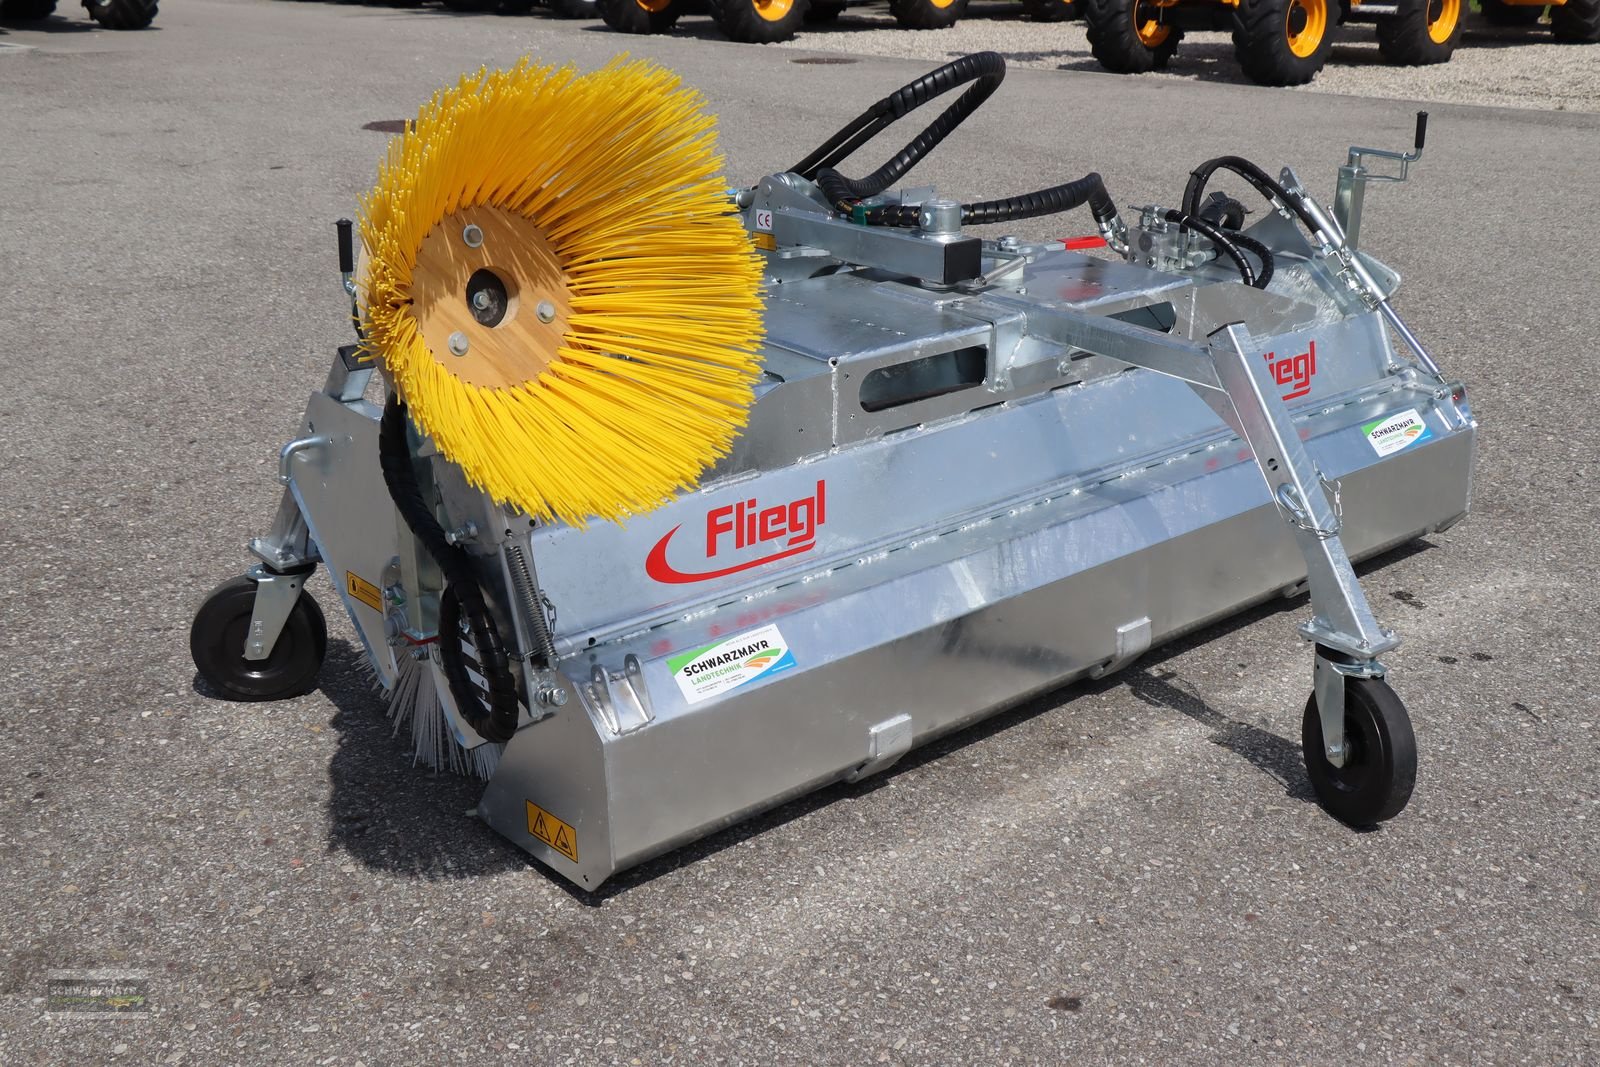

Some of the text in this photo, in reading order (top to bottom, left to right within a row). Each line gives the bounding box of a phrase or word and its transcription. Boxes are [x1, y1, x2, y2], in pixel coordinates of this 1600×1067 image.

[1263, 340, 1316, 390] iegl
[1371, 418, 1415, 440] SCHWARZMAYR
[706, 479, 826, 558] Fliegl
[683, 639, 770, 677] SCHWARZMAYR
[691, 662, 742, 685] LANDTECHNIK
